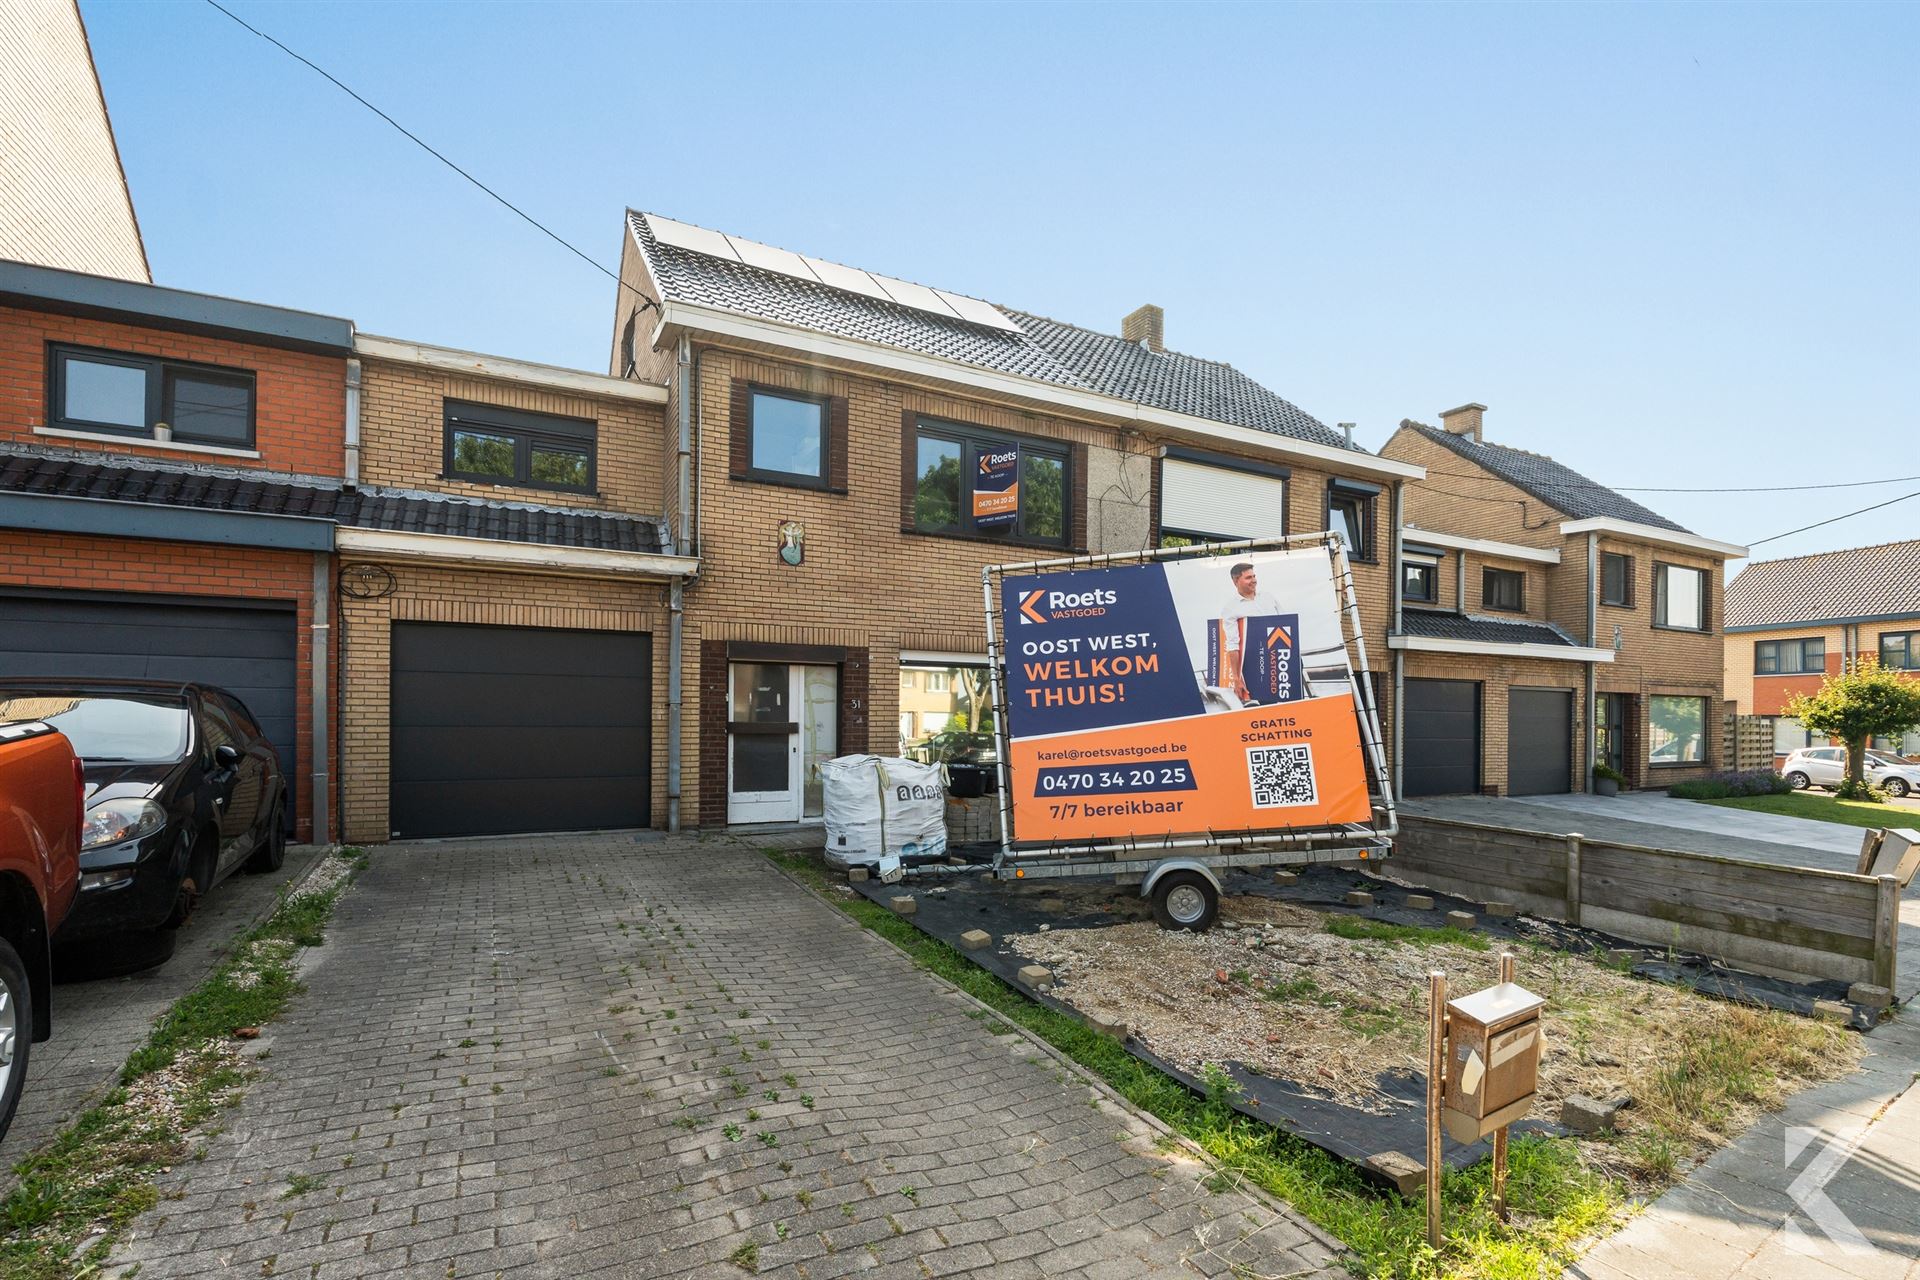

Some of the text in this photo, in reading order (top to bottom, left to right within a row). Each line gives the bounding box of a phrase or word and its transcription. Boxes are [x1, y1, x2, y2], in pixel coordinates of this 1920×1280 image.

[991, 451, 1016, 464] Roets
[1050, 588, 1117, 609] Roets
[1051, 607, 1106, 619] VASTGOED
[1022, 633, 1157, 656] OOST WEST,
[1023, 654, 1159, 682] WELKOM
[1277, 648, 1291, 699] Roets
[851, 699, 861, 709] 31
[1025, 683, 1125, 708] THUIS!
[1250, 717, 1296, 729] GRATIS
[1241, 728, 1313, 742] SCHATTING
[1037, 743, 1187, 761] karel@roetsvastgoed.be
[1043, 768, 1186, 791] 0470 34 20 25
[1050, 800, 1184, 820] 7/7 bereikbaar
